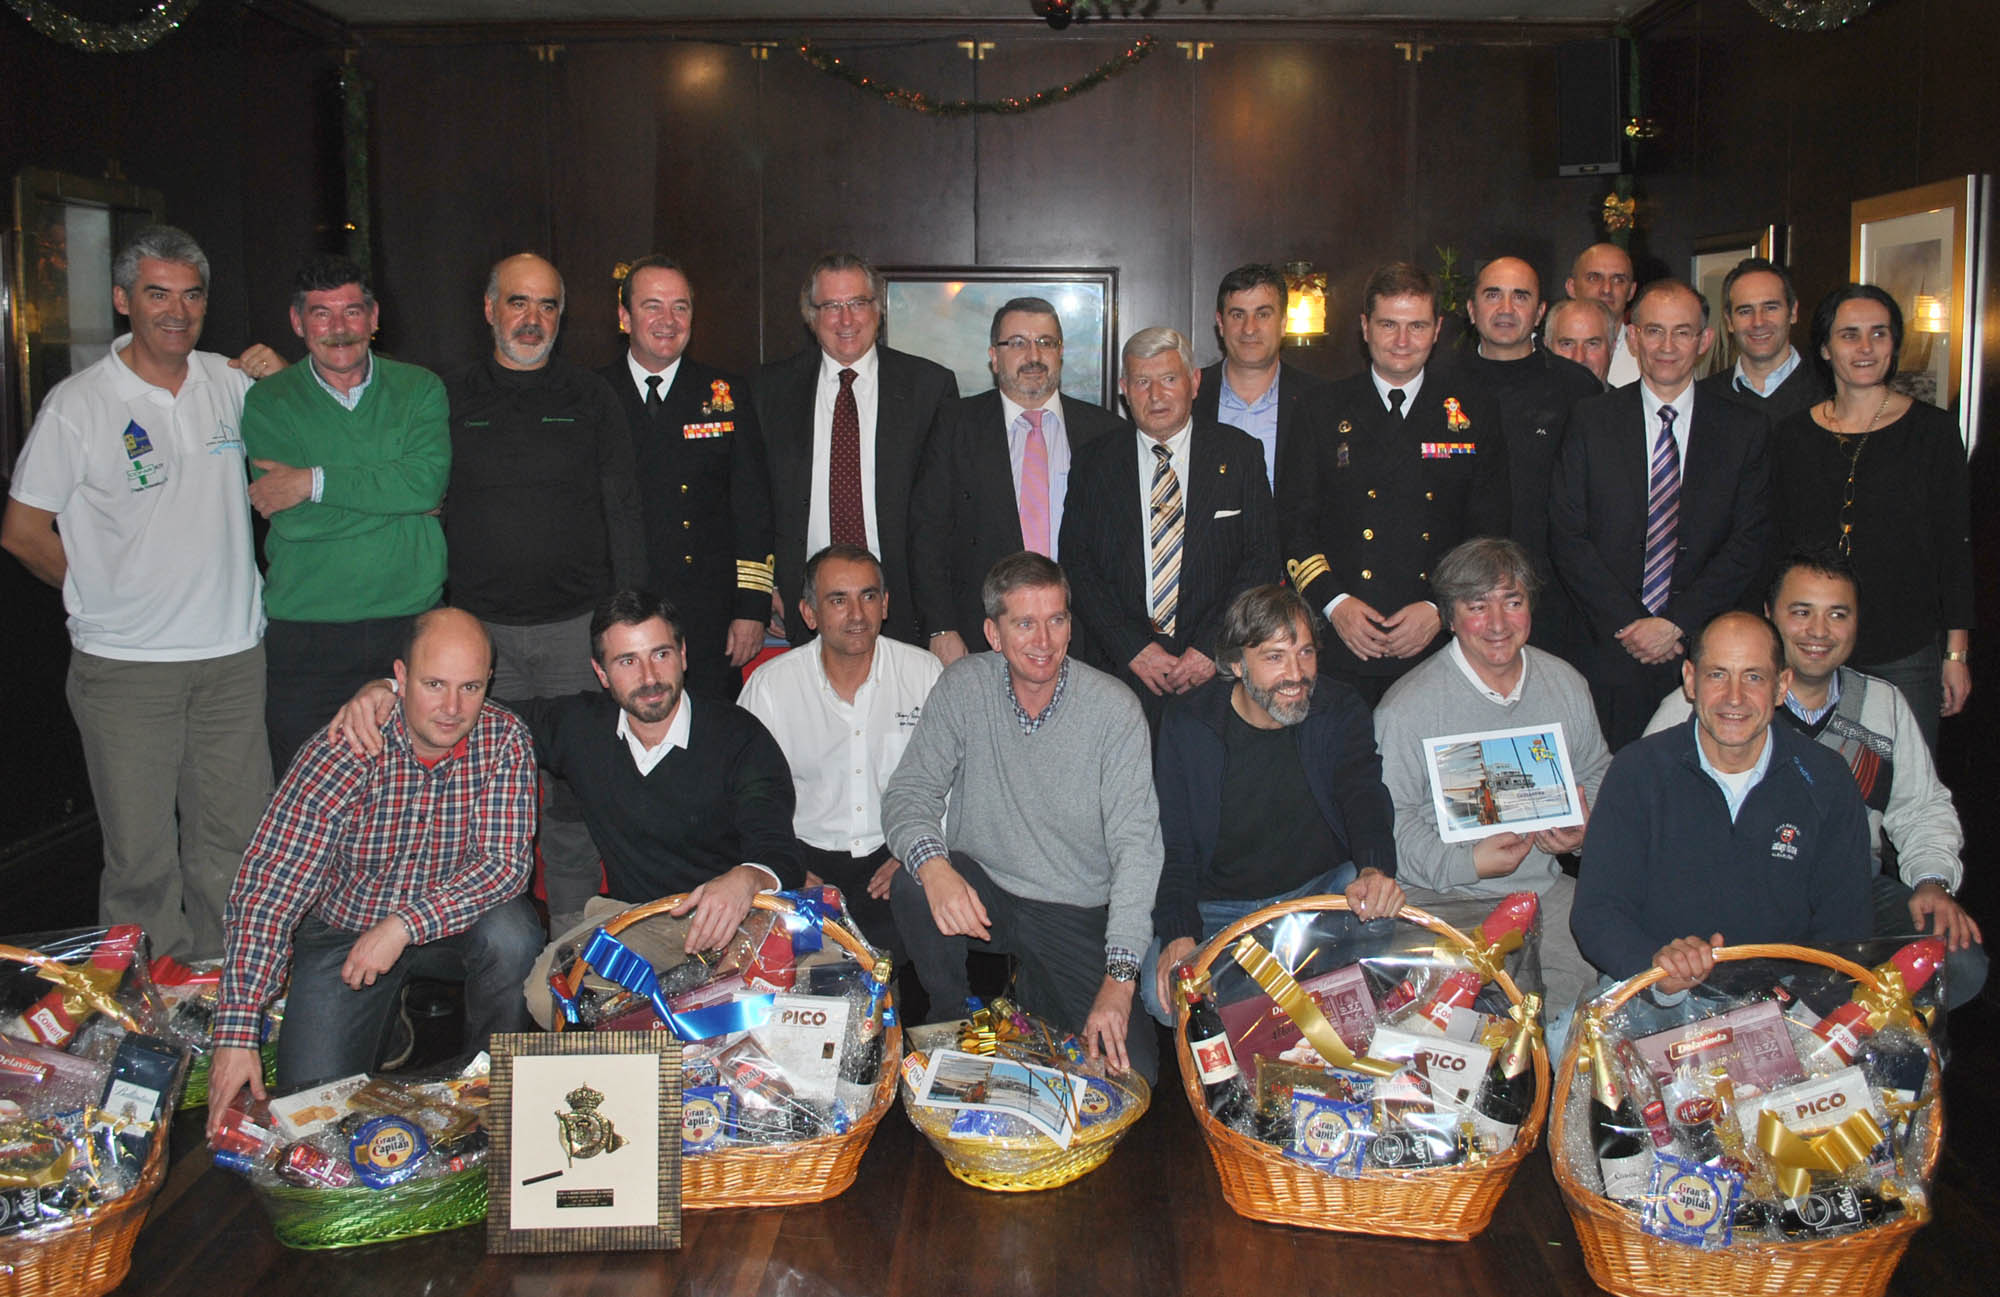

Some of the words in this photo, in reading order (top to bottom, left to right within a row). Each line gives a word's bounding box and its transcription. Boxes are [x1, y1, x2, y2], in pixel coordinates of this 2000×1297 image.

[782, 1010, 827, 1025] PICO
[1424, 1051, 1466, 1071] PICO
[1795, 1092, 1846, 1119] PICO
[376, 1135, 396, 1146] Gran
[1679, 1183, 1700, 1196] Gran
